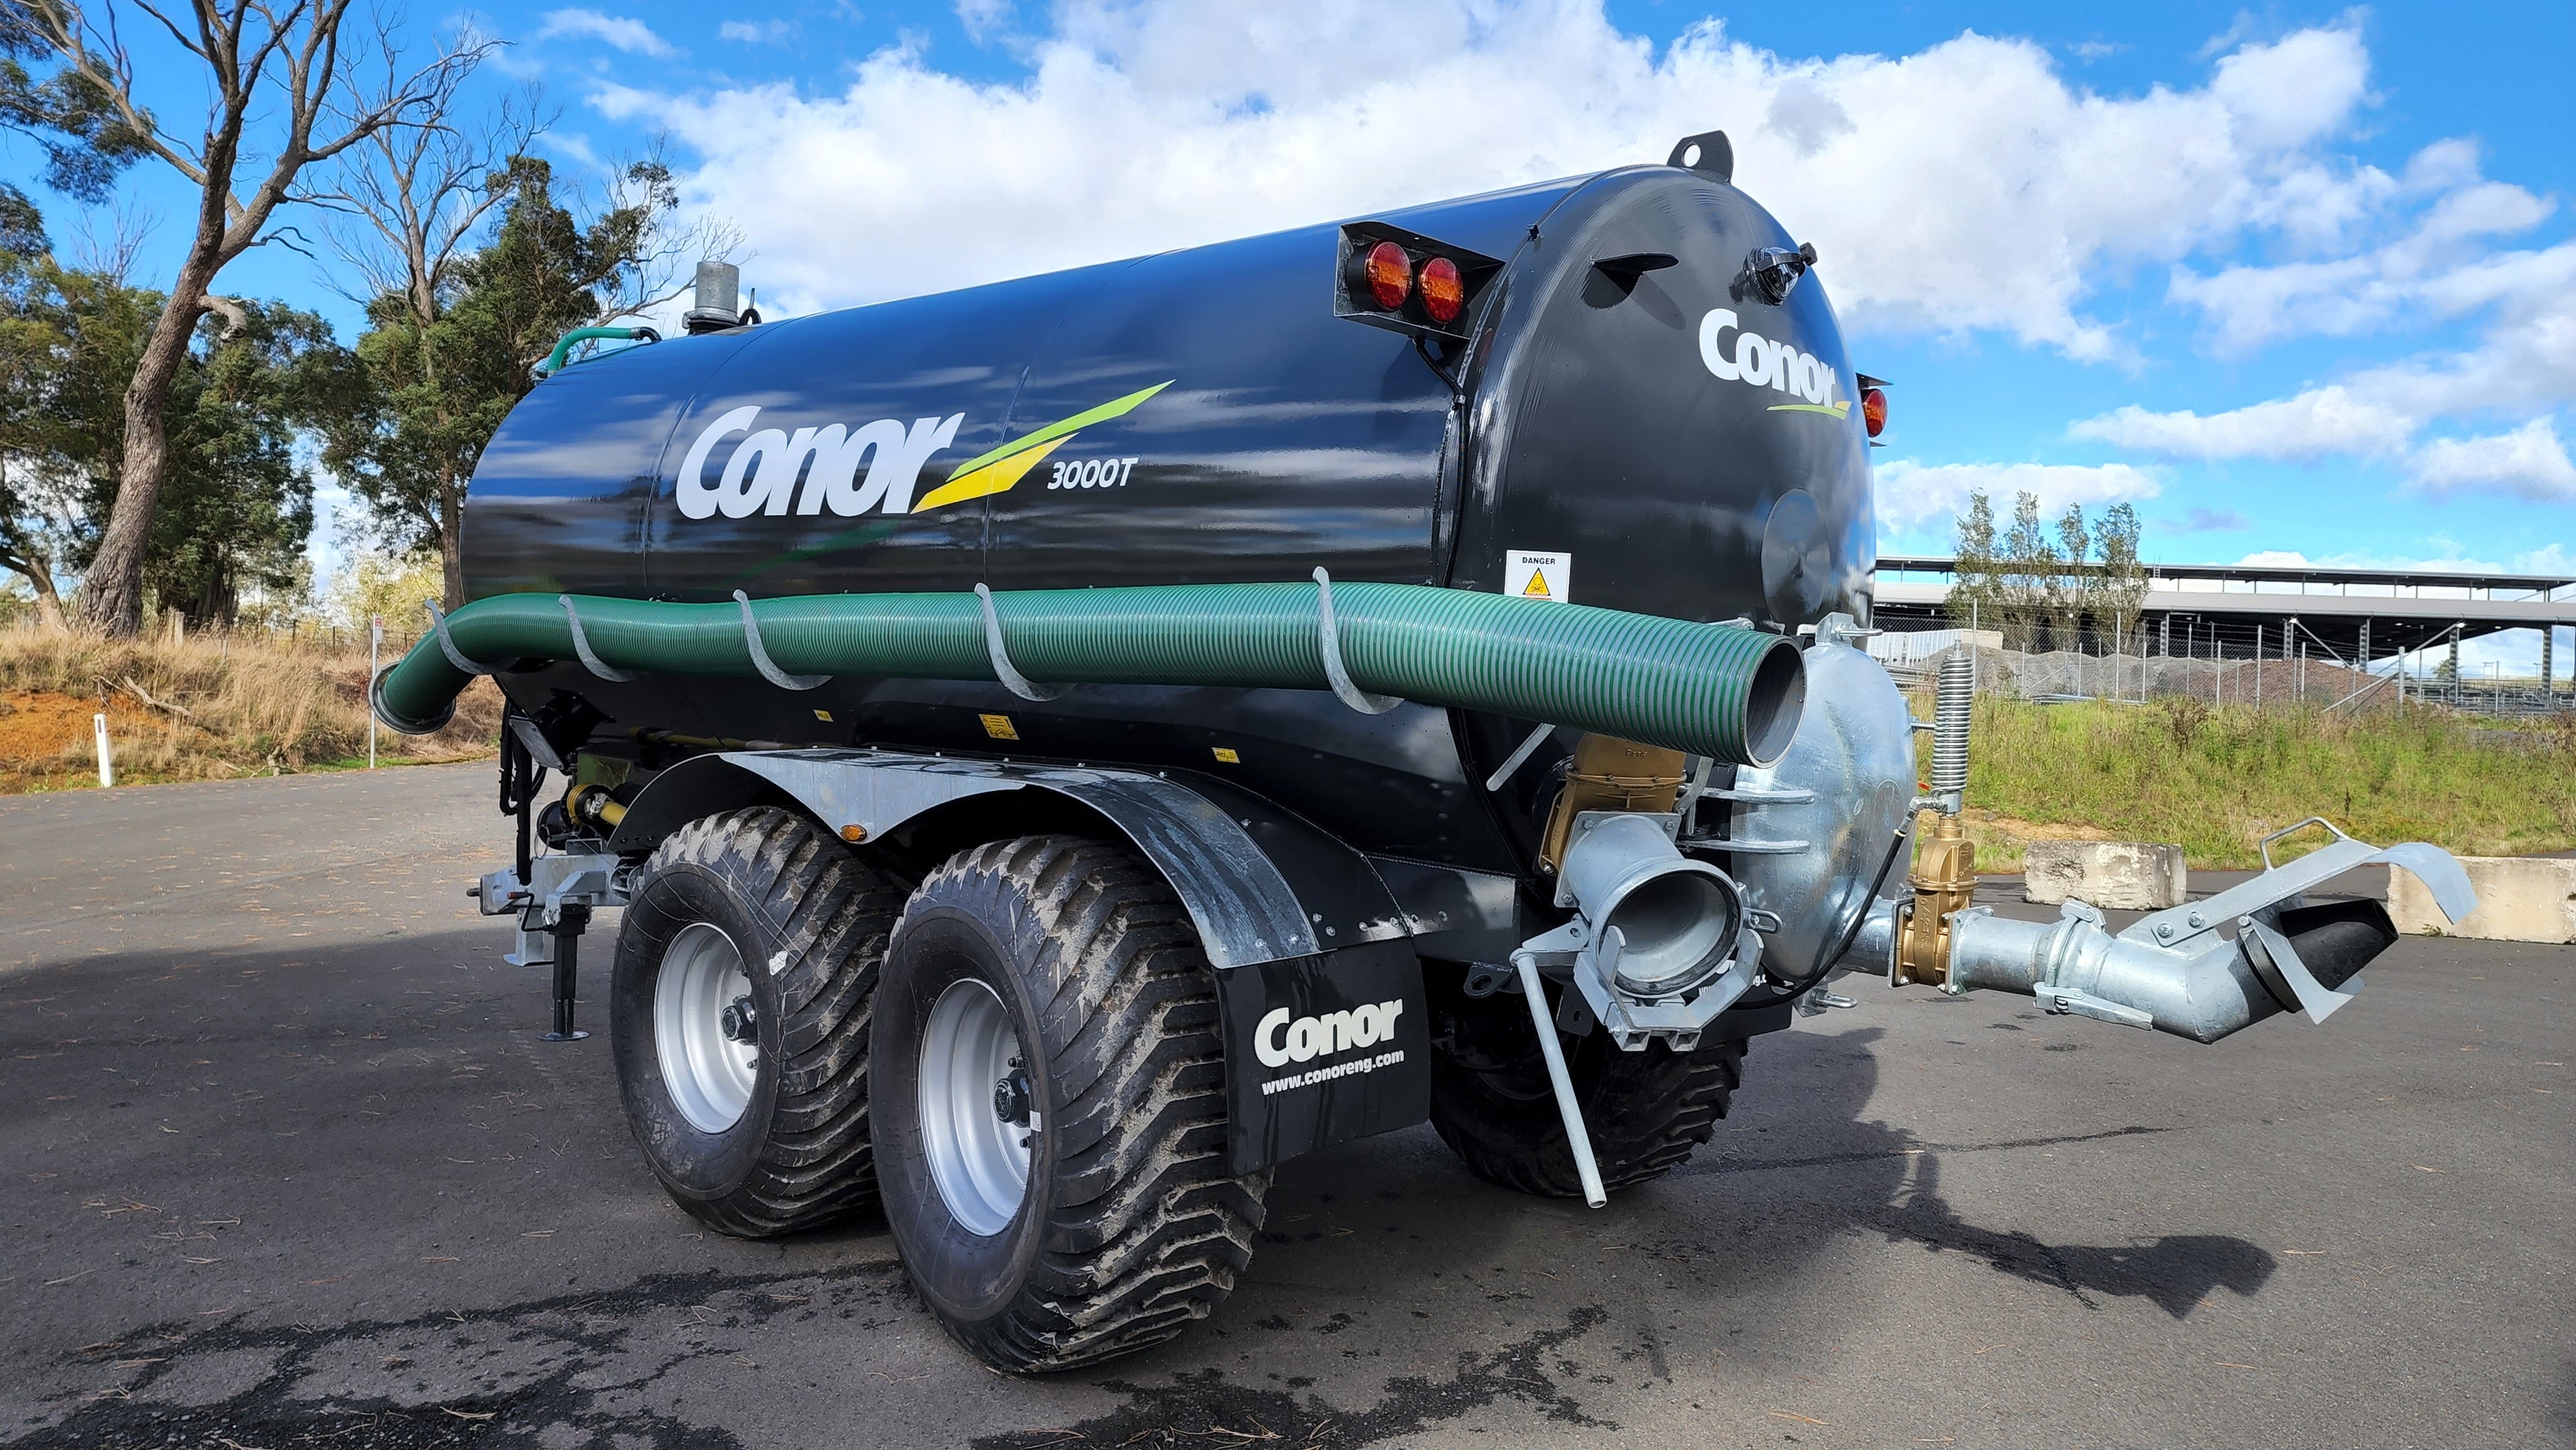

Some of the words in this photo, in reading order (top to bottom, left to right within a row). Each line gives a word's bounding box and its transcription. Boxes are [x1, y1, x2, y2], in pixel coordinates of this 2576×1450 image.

[1699, 308, 1836, 408] Conor
[676, 405, 965, 520] Conor
[1046, 457, 1139, 490] 3000T
[1521, 556, 1556, 565] DANGER
[1254, 998, 1403, 1068] Conor
[1261, 1050, 1405, 1096] www.conoreng.com
